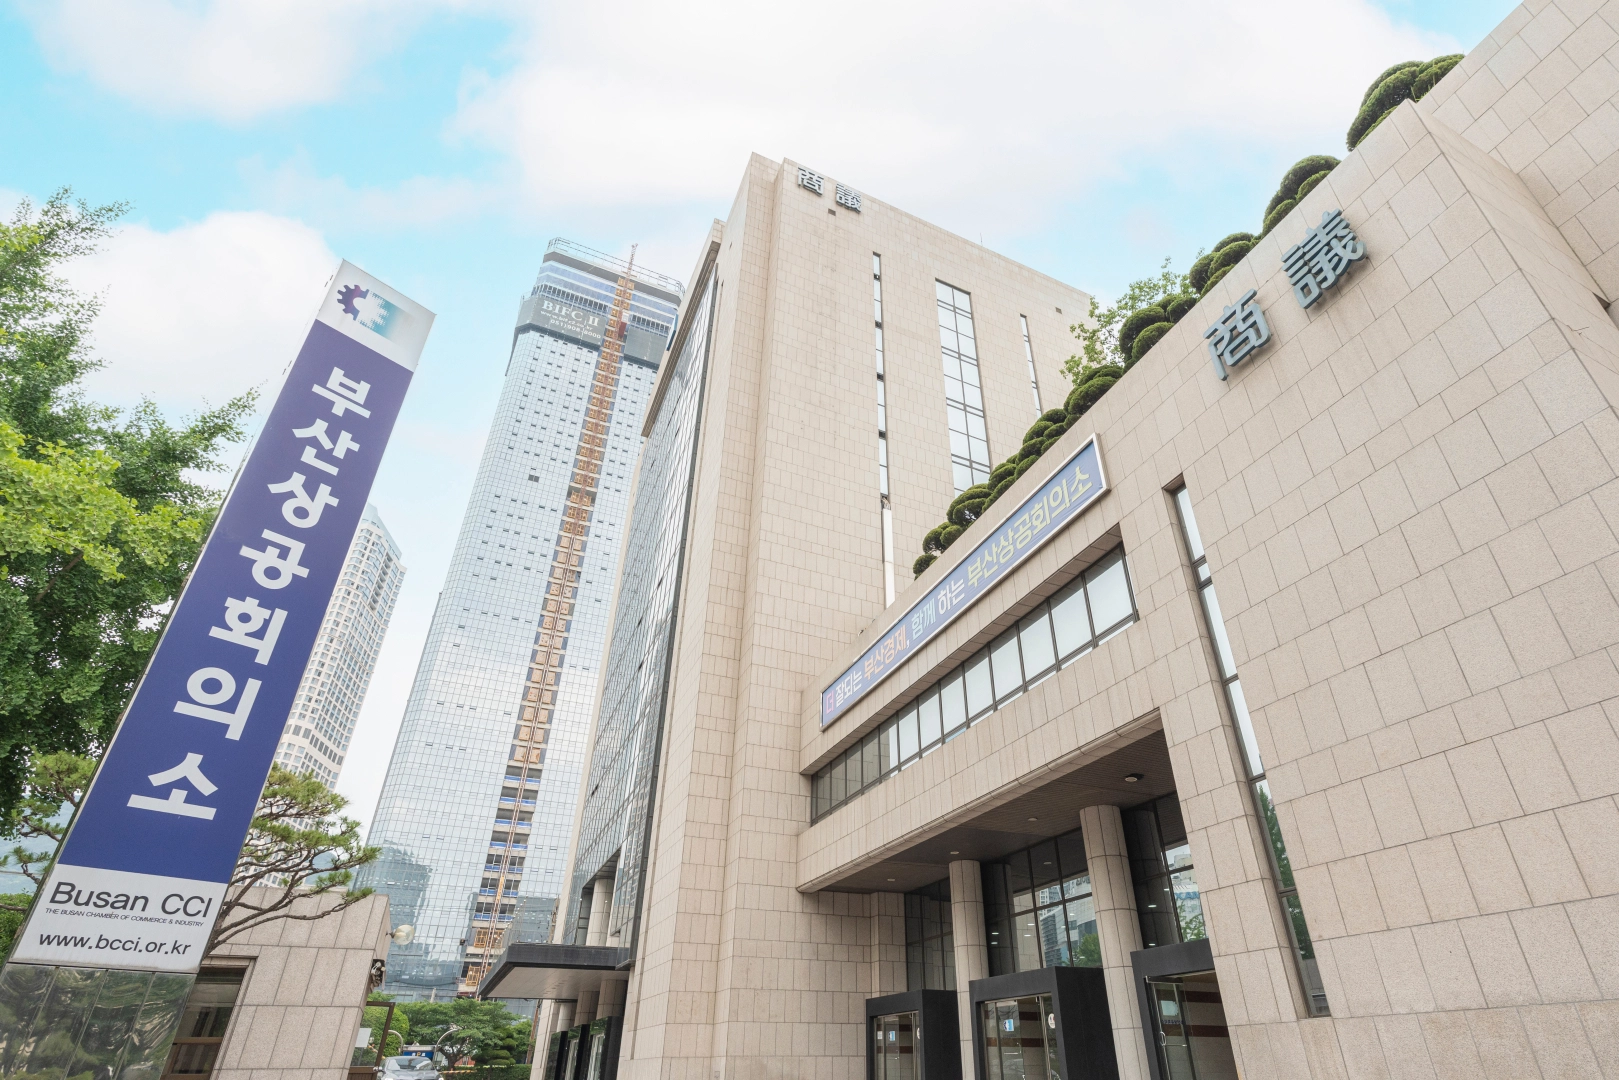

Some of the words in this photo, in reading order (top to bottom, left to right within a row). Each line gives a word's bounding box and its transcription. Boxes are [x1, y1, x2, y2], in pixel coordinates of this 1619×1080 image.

[541, 300, 583, 321] BIFC
[127, 366, 371, 821] 부산상공회의소
[826, 690, 835, 714] 더
[835, 670, 863, 708] 잘되는
[863, 624, 910, 680] 부산경제,
[911, 598, 936, 640] 함께
[937, 578, 966, 615] 하는
[967, 466, 1093, 588] 부산상공회의소
[49, 881, 149, 912] Busan
[161, 893, 213, 918] CCI
[86, 911, 119, 919] CHAMBER
[130, 915, 168, 924] COMMERCE
[174, 919, 204, 927] INDUSTRY
[39, 933, 191, 955] www.bcci.or.kr
